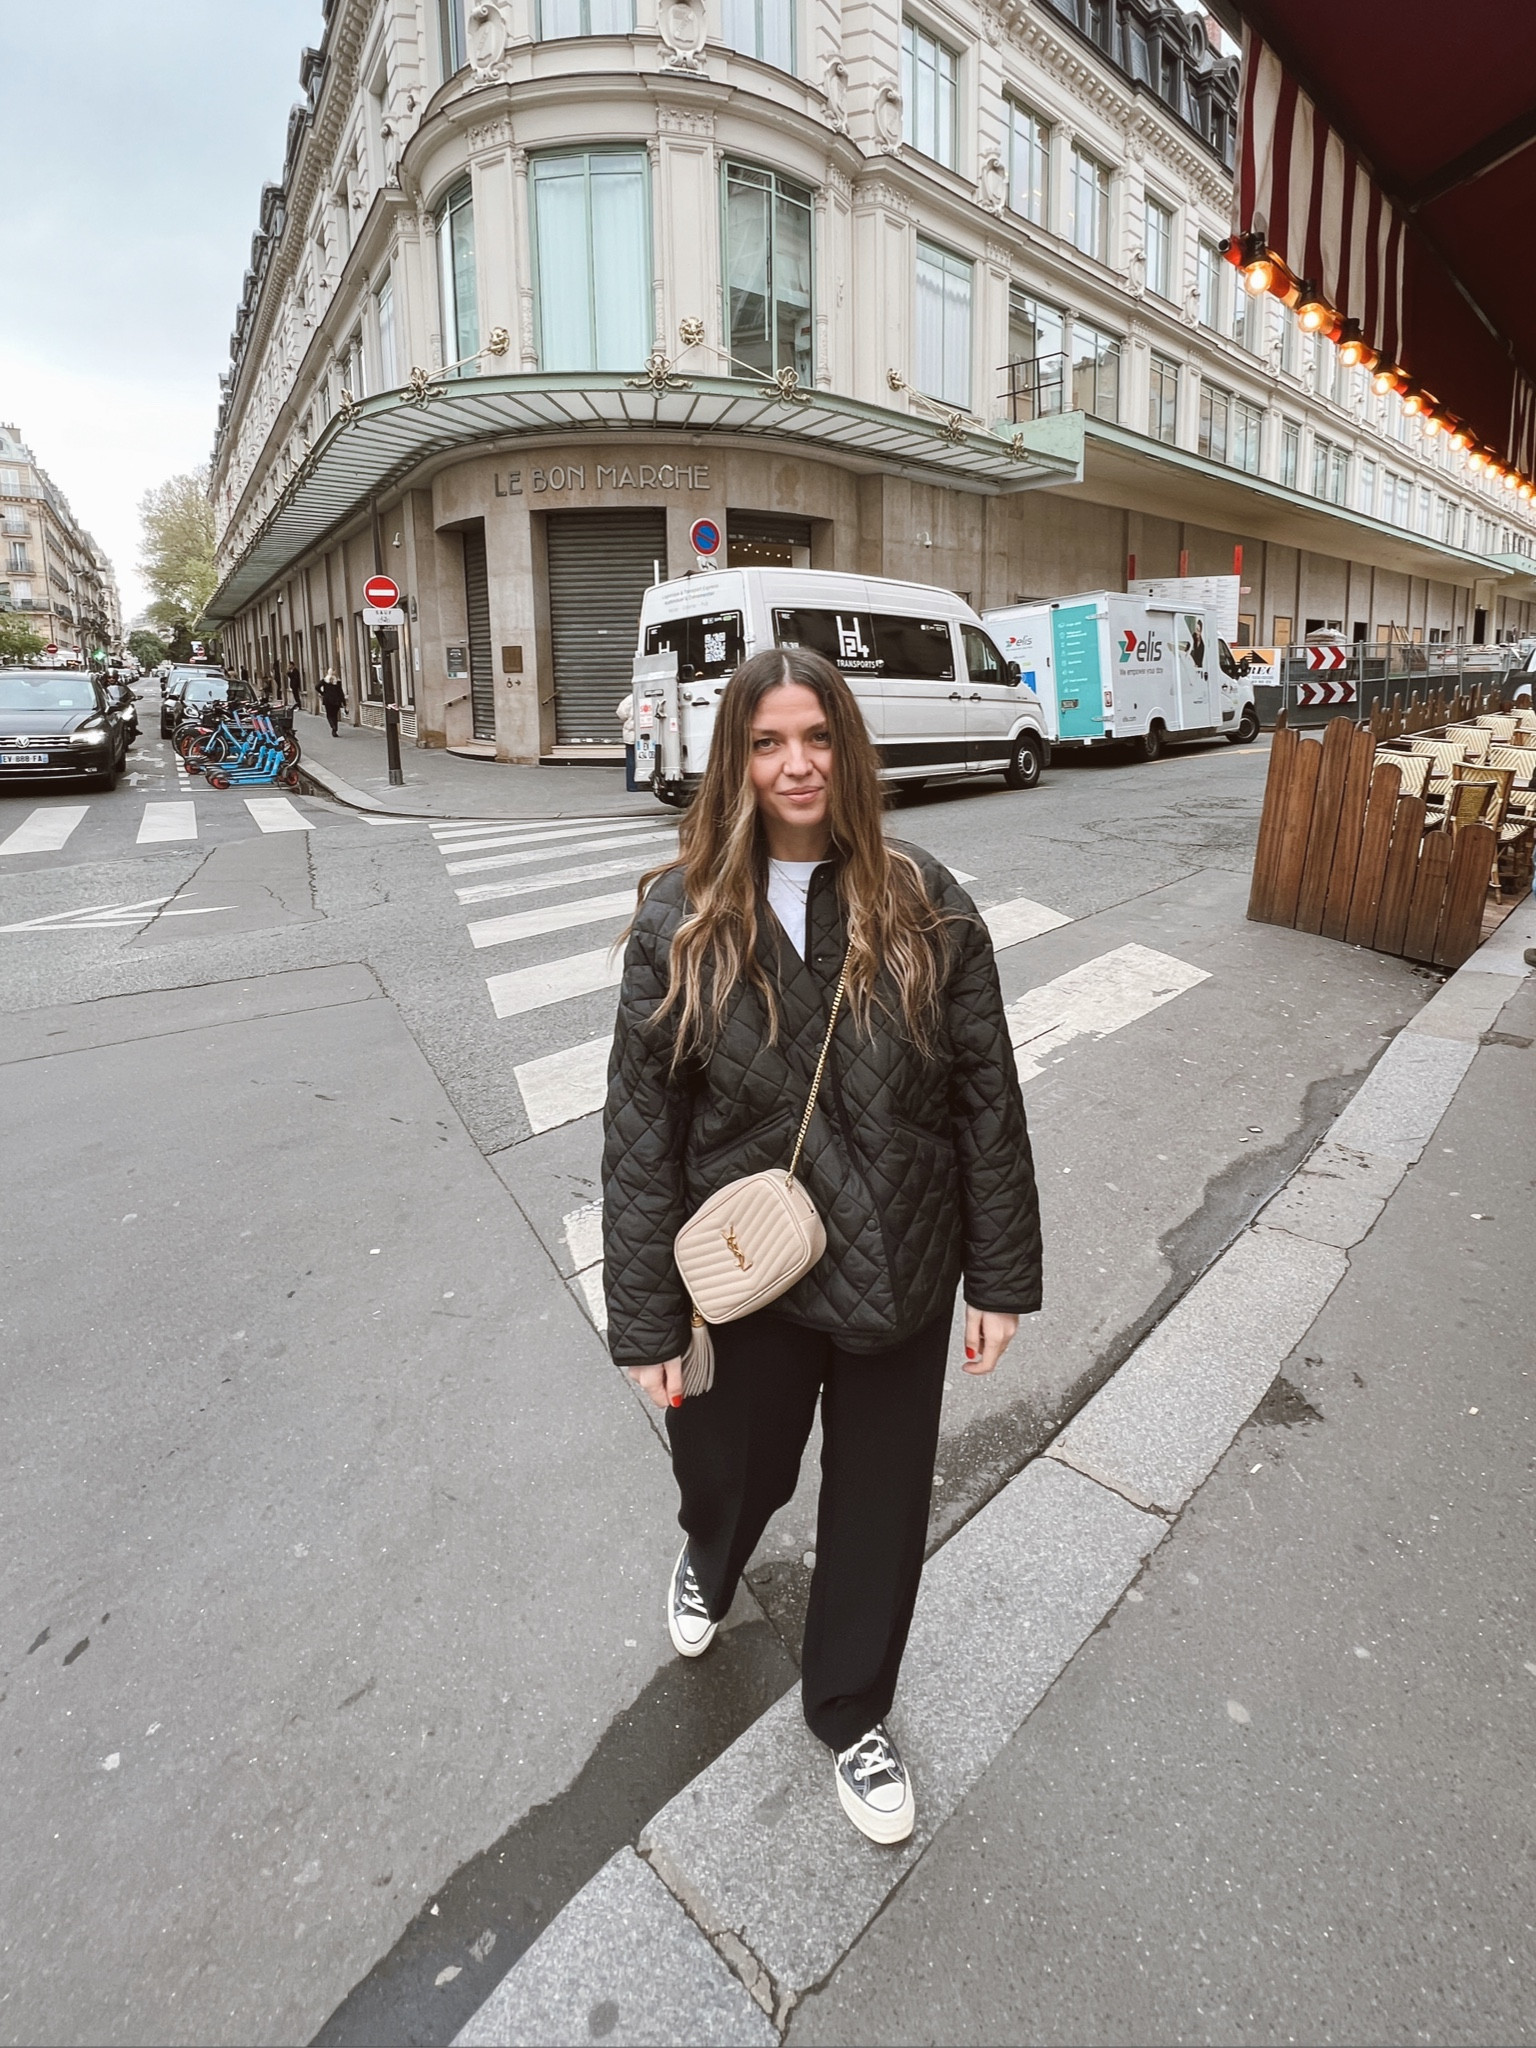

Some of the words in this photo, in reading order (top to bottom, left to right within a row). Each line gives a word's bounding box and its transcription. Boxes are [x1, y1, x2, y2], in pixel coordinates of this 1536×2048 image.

[494, 471, 523, 497] LE
[533, 465, 586, 493] BON
[596, 464, 711, 490] MARCHE
[1136, 630, 1162, 662] elis
[836, 659, 877, 669] TRANSPORTS
